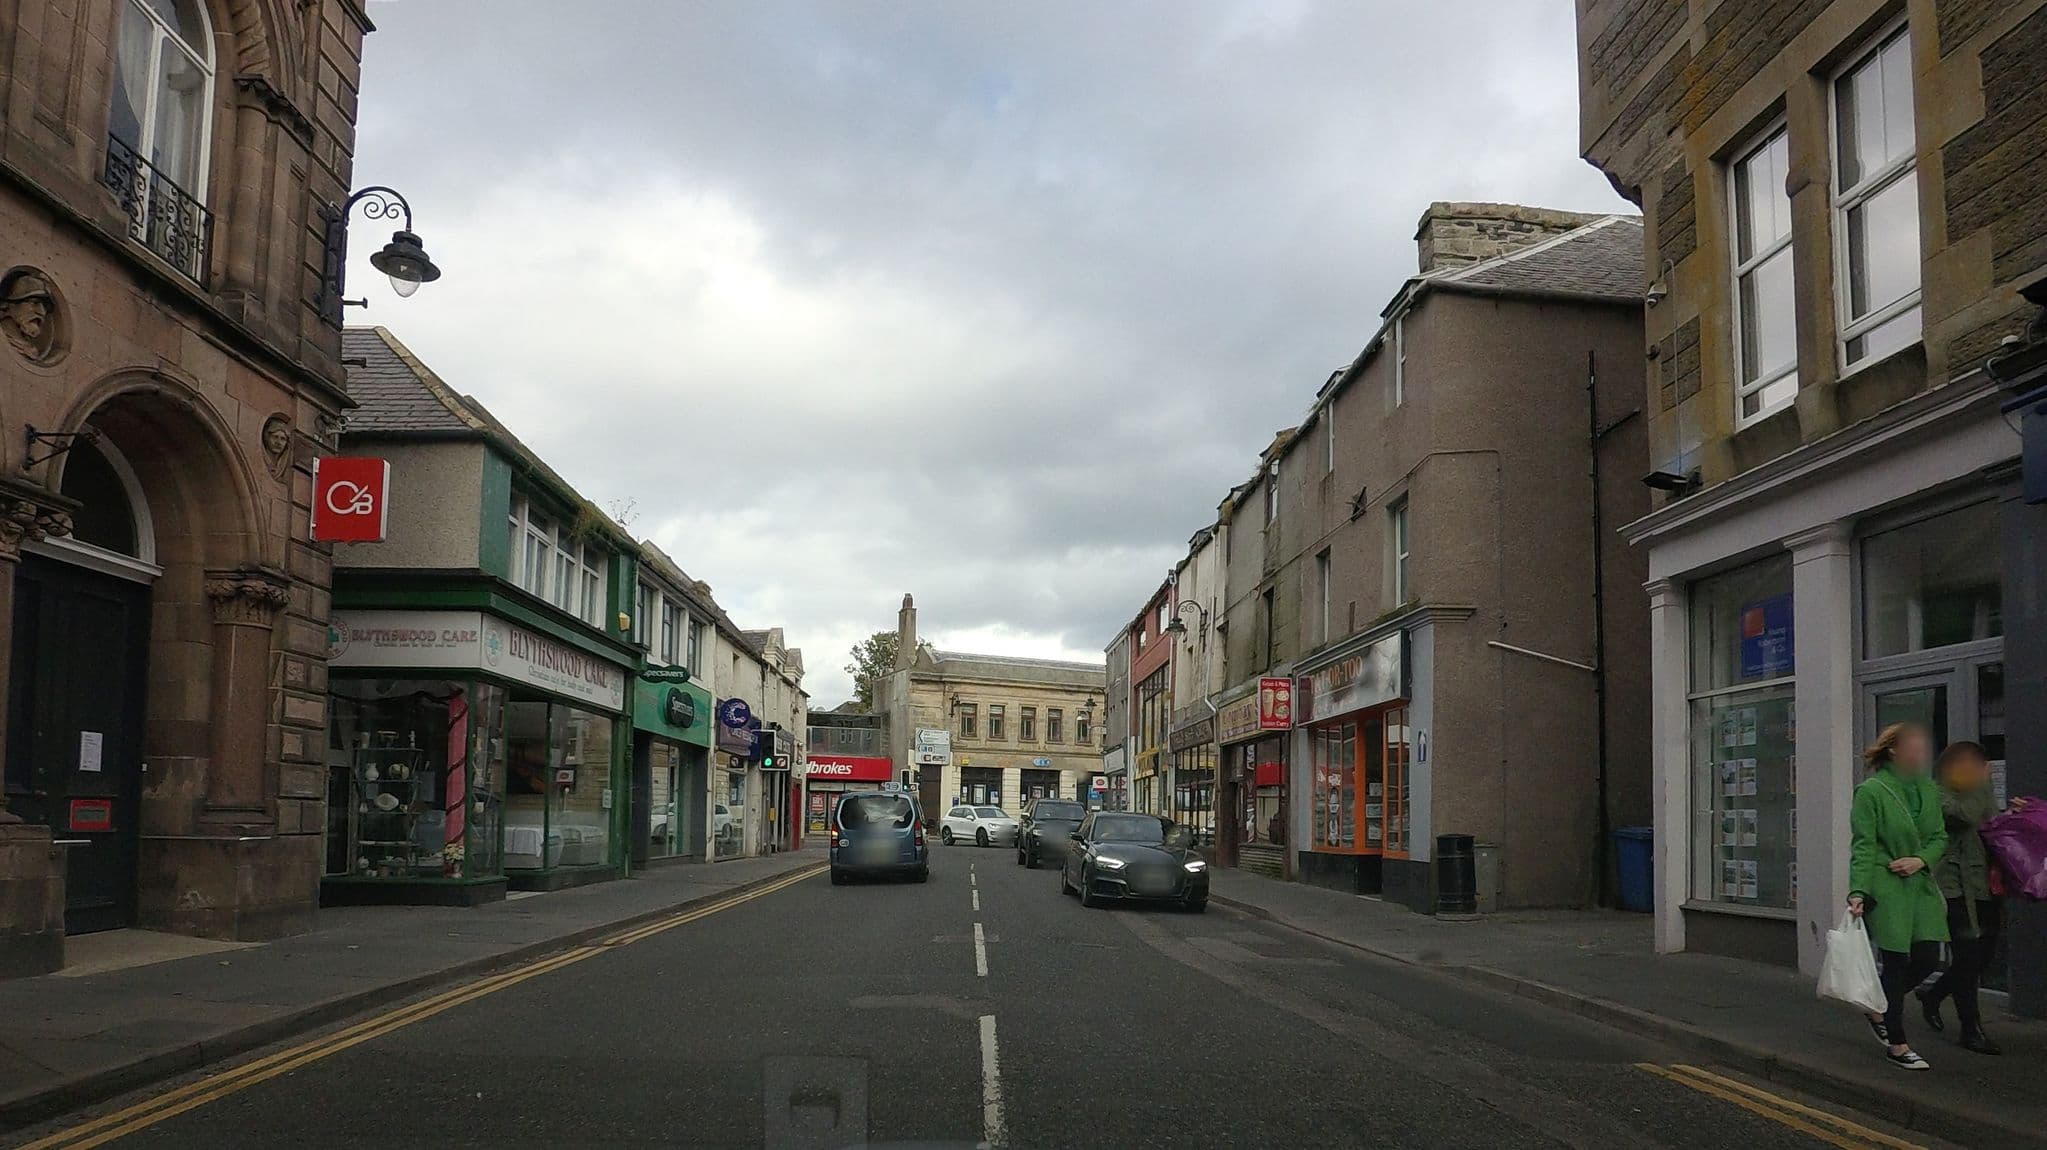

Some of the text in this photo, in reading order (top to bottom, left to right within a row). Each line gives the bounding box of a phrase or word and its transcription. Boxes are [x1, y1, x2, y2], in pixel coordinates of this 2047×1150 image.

[352, 628, 478, 643] BLYTHSWOOD CARE
[509, 629, 582, 679] BLYTHSWOOD
[583, 659, 608, 689] CARE
